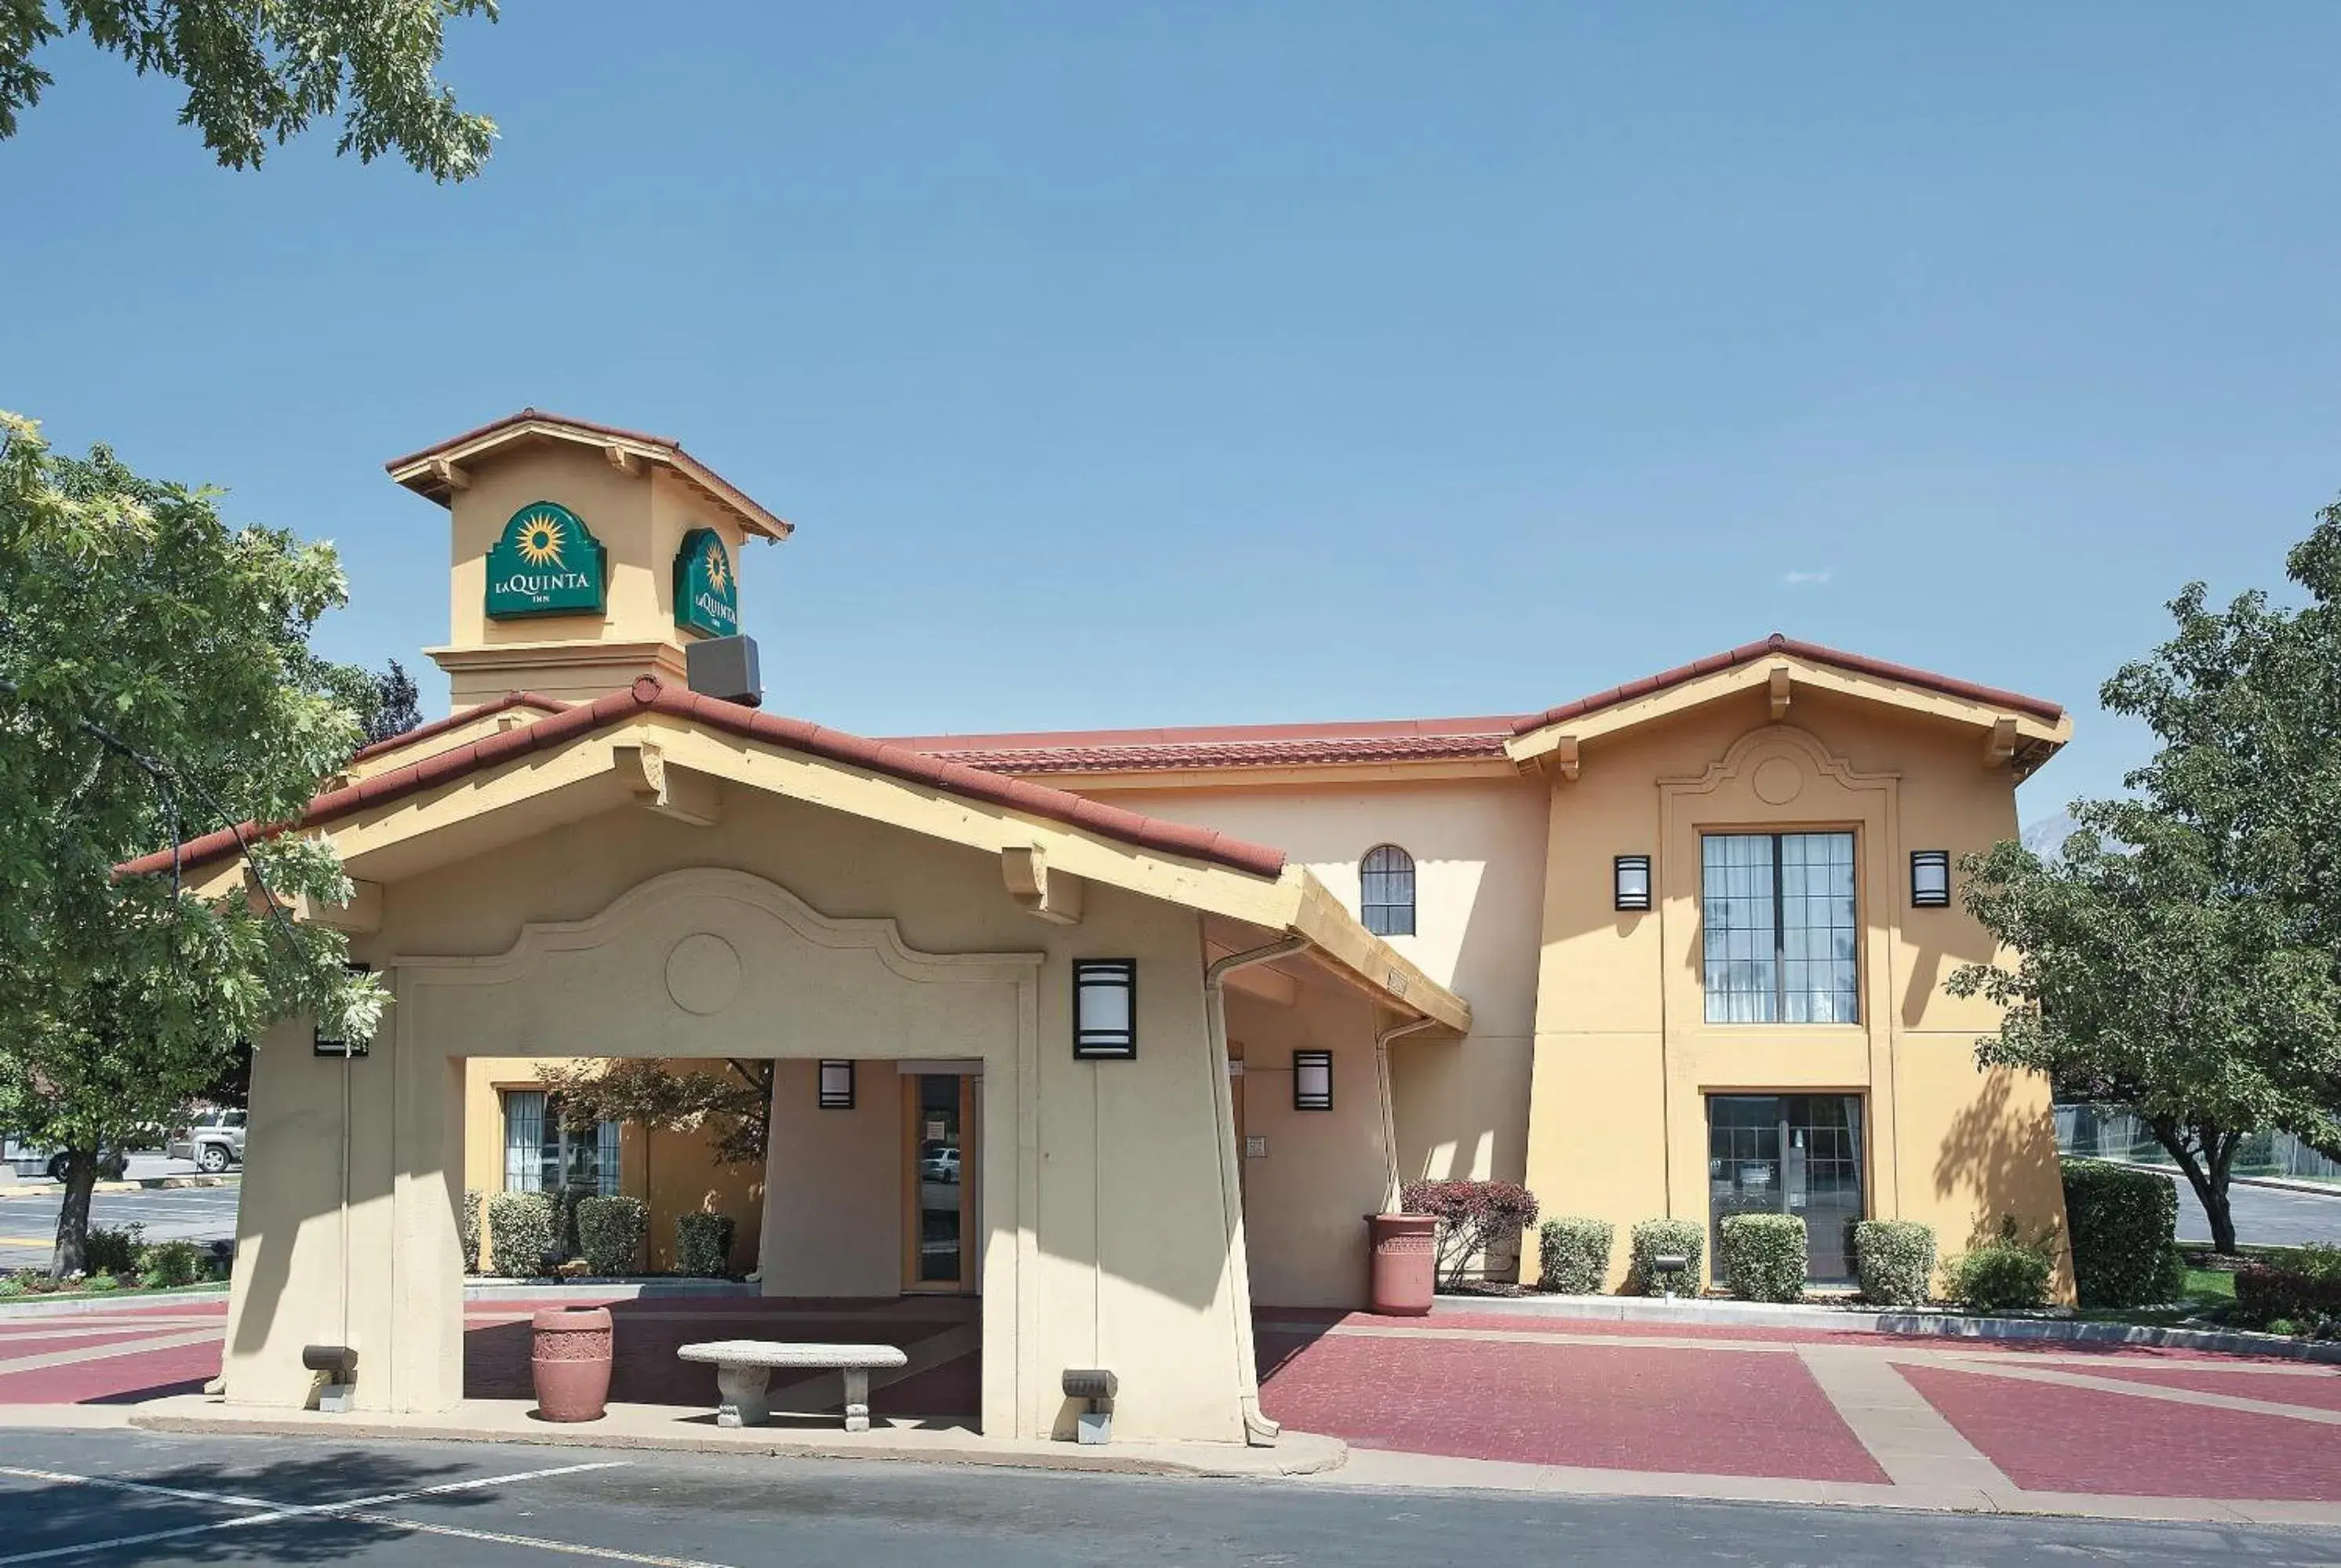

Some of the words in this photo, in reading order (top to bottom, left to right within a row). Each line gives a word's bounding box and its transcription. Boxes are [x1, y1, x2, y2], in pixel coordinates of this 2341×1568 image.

[495, 581, 510, 594] LA
[510, 572, 590, 595] QUINTA
[703, 592, 737, 625] QUINTA
